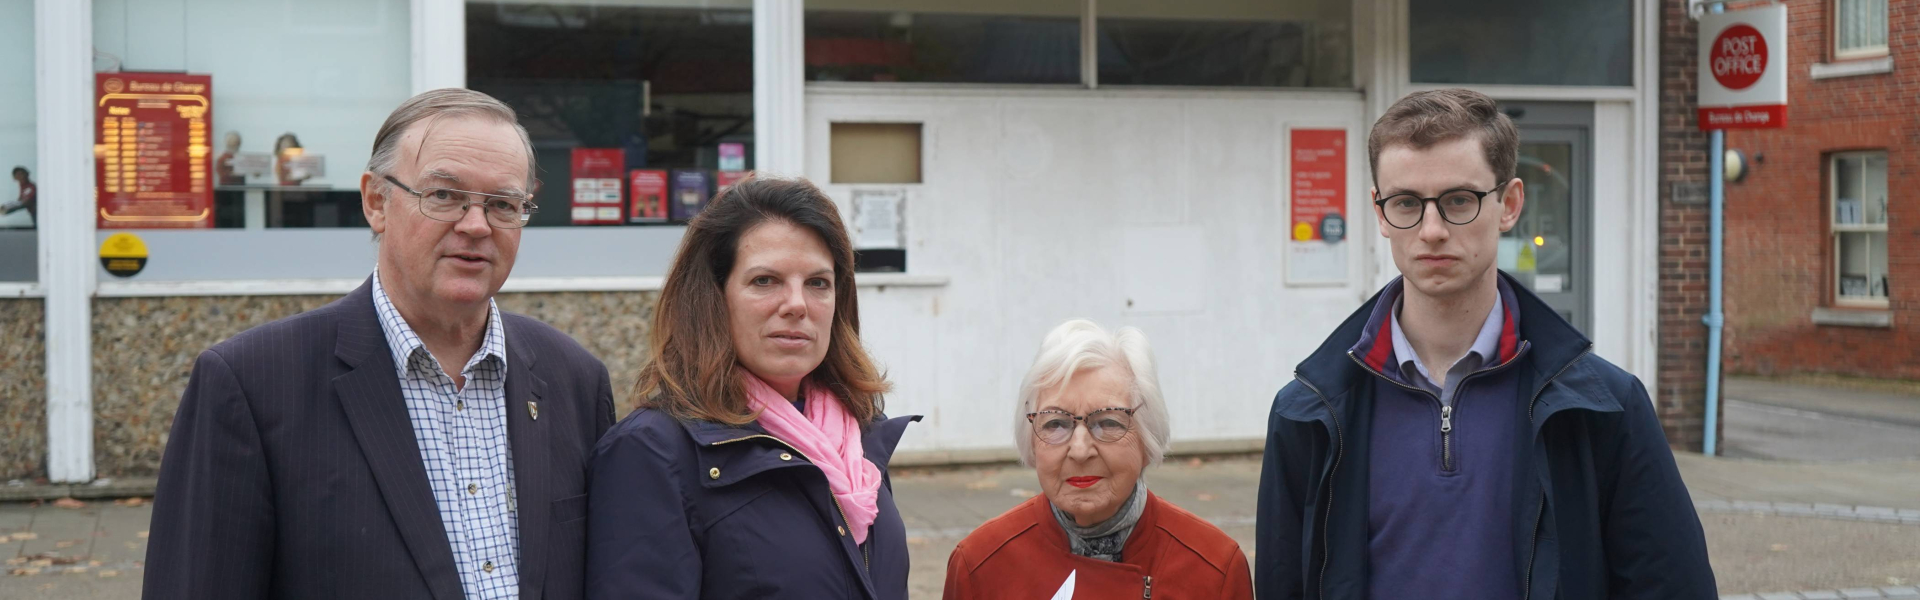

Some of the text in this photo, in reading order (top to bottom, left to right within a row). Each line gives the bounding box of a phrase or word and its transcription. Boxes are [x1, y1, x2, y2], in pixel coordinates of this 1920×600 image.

[1722, 35, 1757, 57] POST
[1714, 54, 1762, 76] OFFICE
[129, 80, 160, 92] Bureau
[161, 82, 172, 92] de
[173, 81, 205, 94] Change
[1709, 109, 1769, 124] Bureau de Change
